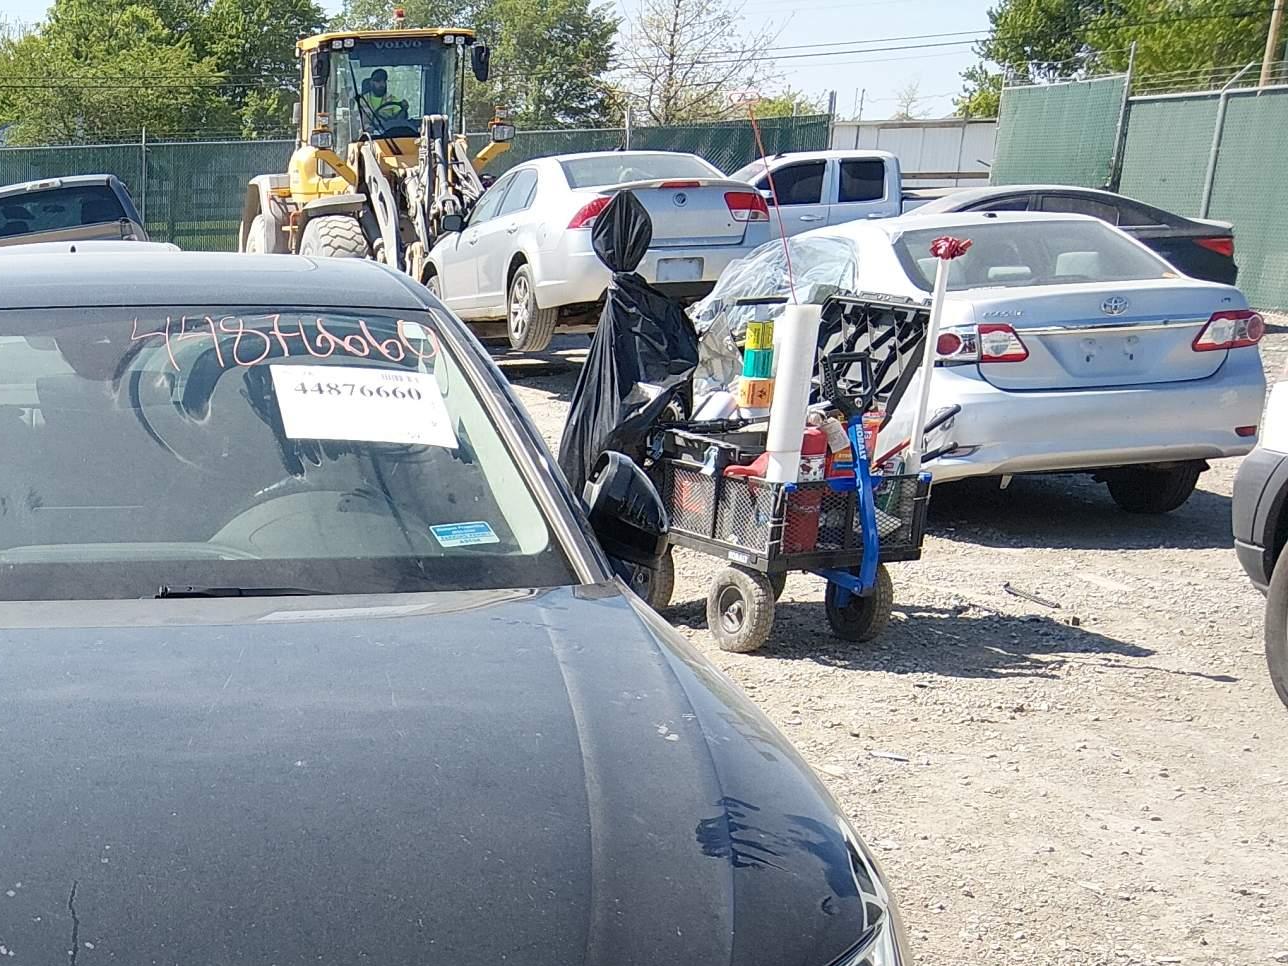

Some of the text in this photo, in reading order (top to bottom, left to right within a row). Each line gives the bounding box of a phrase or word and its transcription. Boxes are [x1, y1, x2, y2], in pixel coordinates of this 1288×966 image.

[375, 41, 422, 49] VOLVO
[294, 382, 422, 401] 44876660
[855, 423, 867, 460] KOBALT
